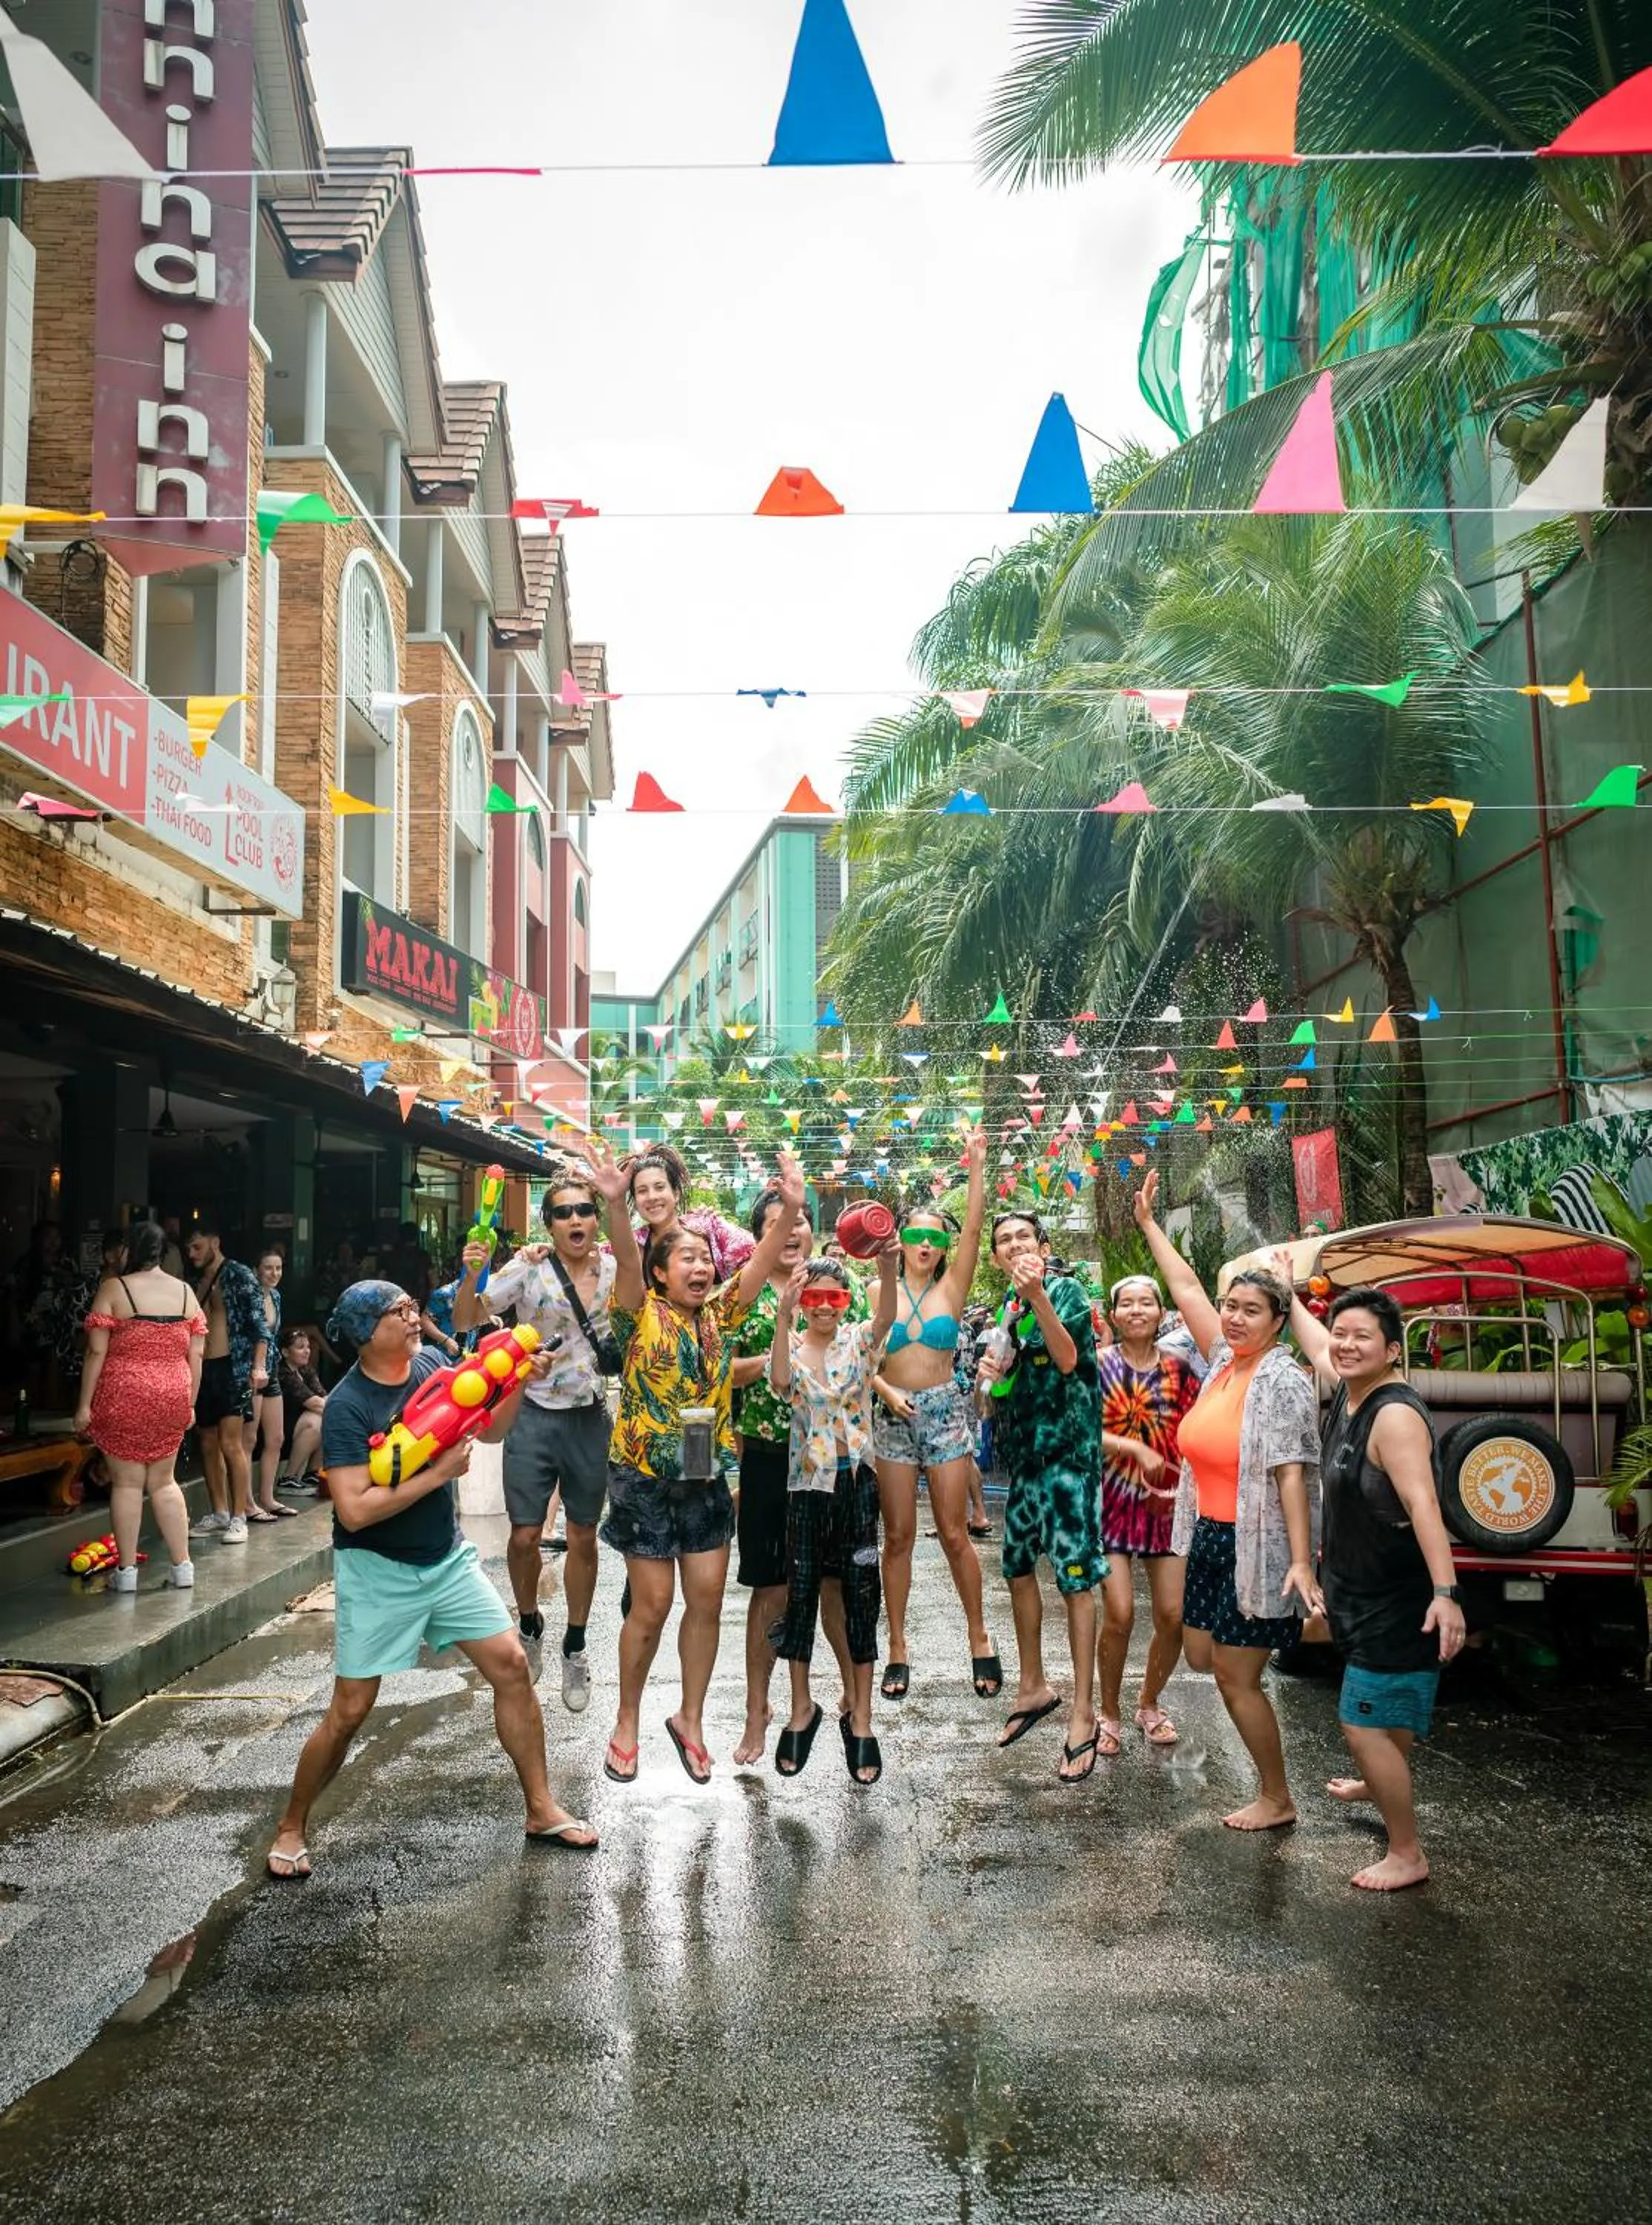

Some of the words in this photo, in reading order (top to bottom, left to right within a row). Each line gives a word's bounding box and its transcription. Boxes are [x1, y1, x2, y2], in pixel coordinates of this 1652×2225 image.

[183, 813, 213, 847] FOOD
[236, 805, 264, 843] POOL
[234, 833, 262, 869] CLUB
[365, 917, 458, 1005] MAKAI
[1467, 1446, 1503, 1477] BETTER
[1466, 1478, 1484, 1514] TASTE
[1530, 1492, 1547, 1516] THE
[1484, 1512, 1530, 1526] WORLD
